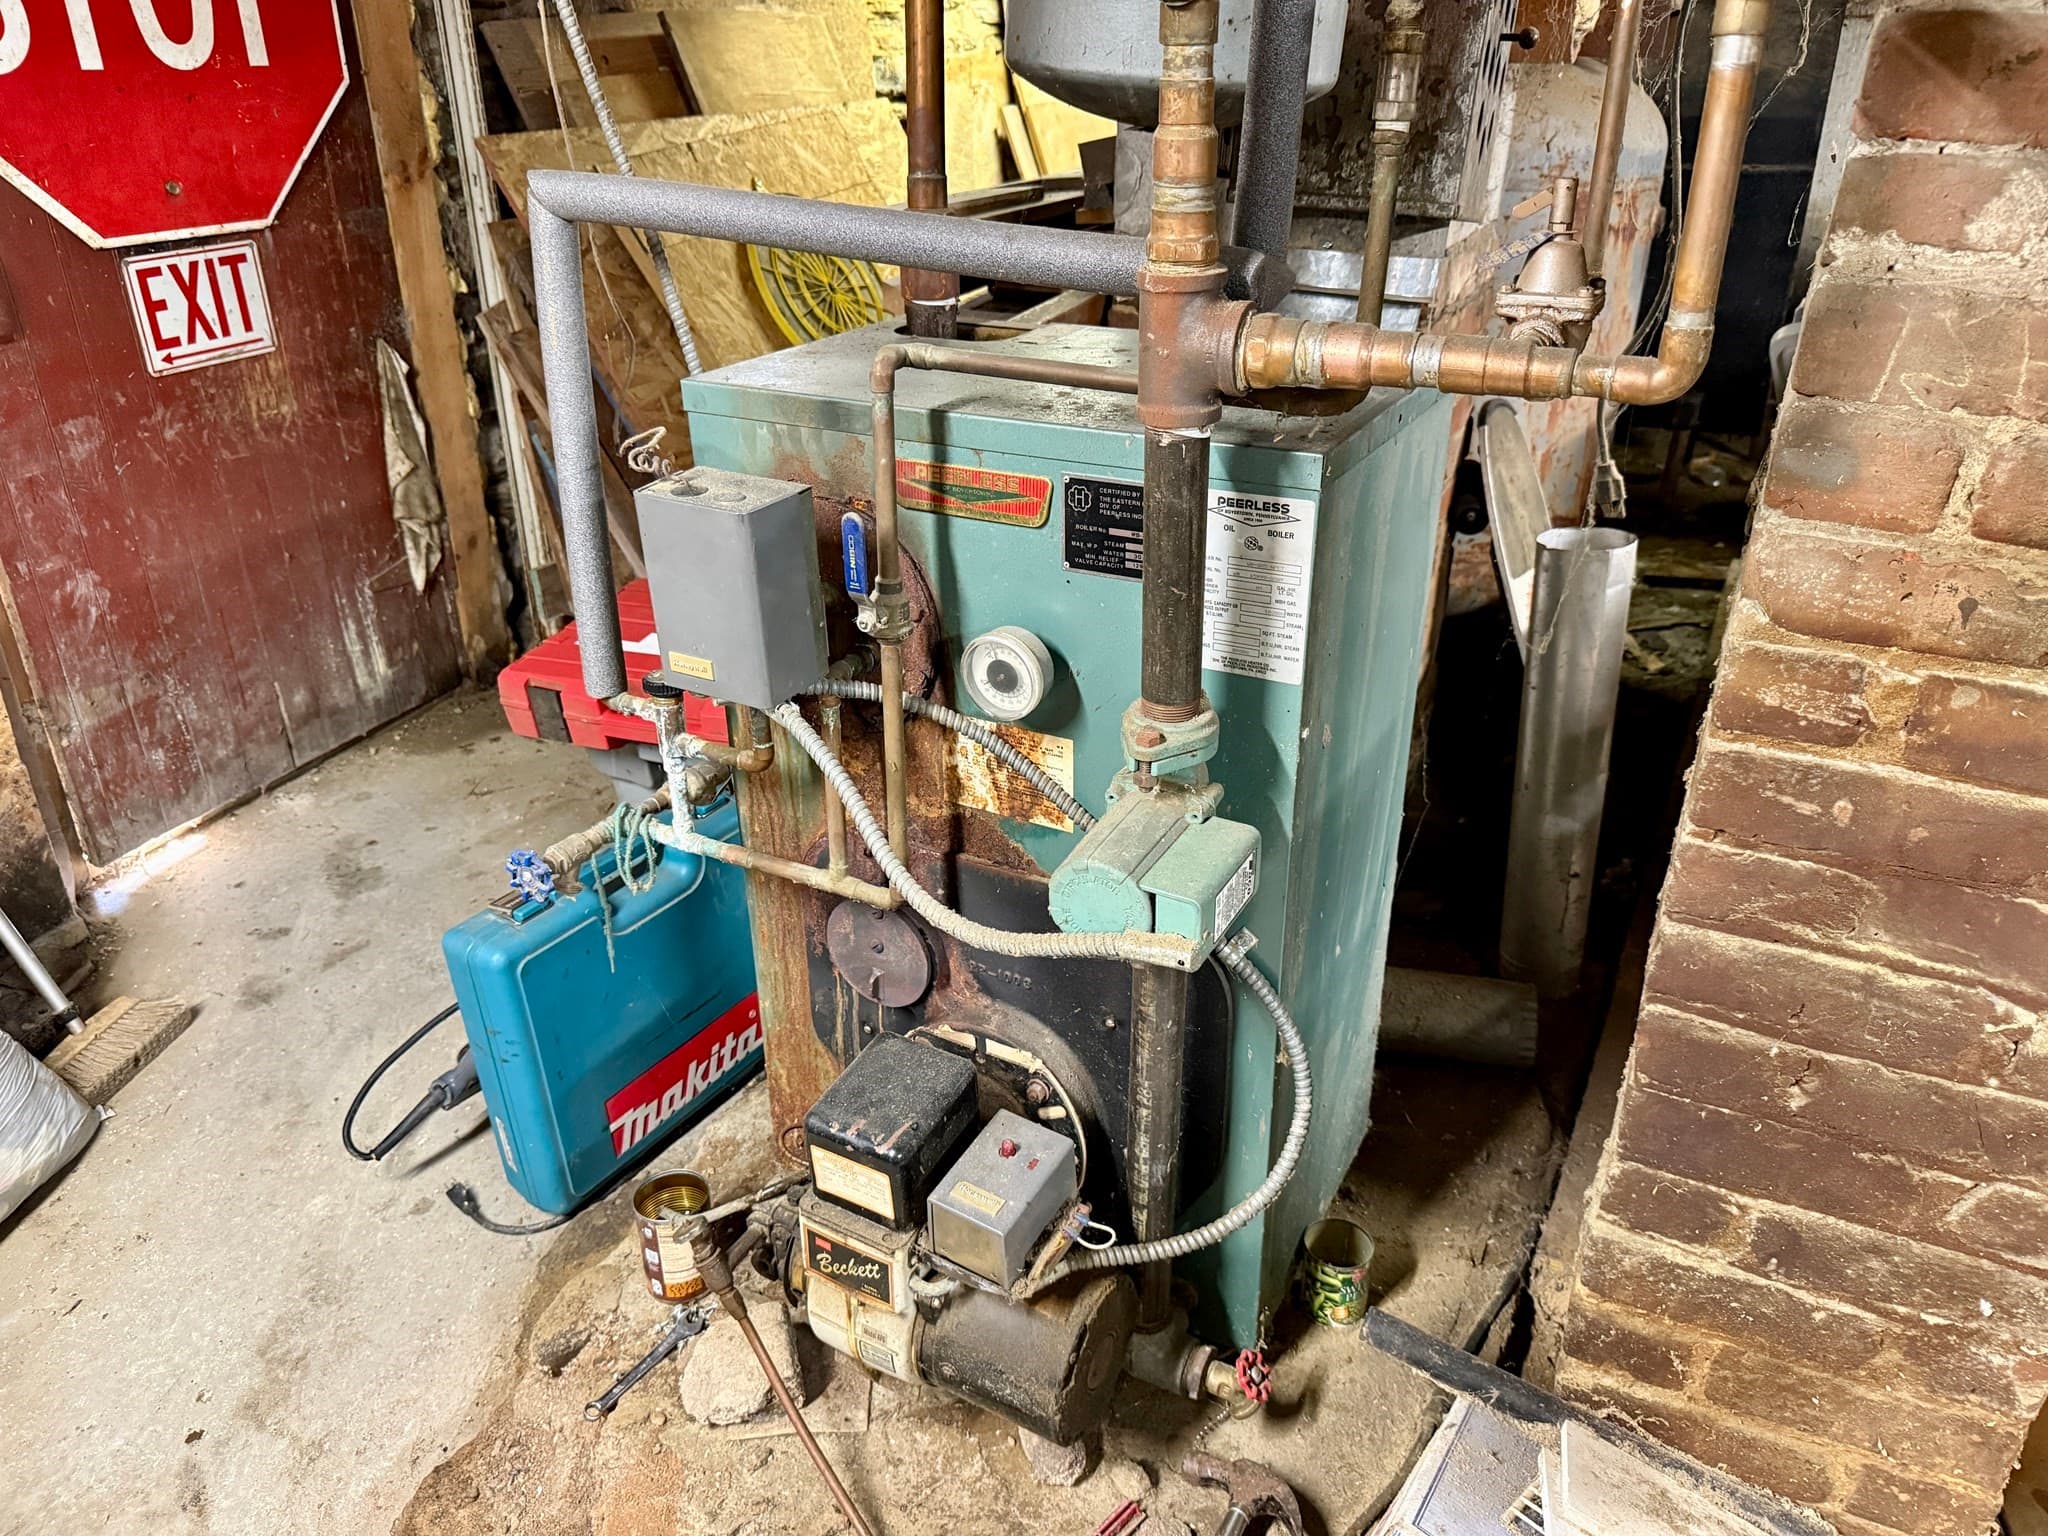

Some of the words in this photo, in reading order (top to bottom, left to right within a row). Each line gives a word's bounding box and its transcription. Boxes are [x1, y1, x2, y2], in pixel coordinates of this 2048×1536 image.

[135, 253, 254, 351] EXIT
[1099, 487, 1131, 497] CERTIFIED
[1099, 495, 1111, 503] THE
[1112, 497, 1141, 507] EASTERN
[1217, 496, 1291, 514] PEERLESS
[1099, 508, 1131, 519] PEERLESS
[1075, 523, 1098, 532] BOILER
[1223, 523, 1236, 533] OIL
[1267, 529, 1295, 540] BOILER
[1103, 540, 1125, 549] STEAM
[1103, 549, 1124, 557] WATER
[1074, 557, 1093, 566] VALVE
[1094, 560, 1124, 569] CAPACITY
[1098, 555, 1119, 563] RELIEF
[815, 1251, 881, 1279] Beckett
